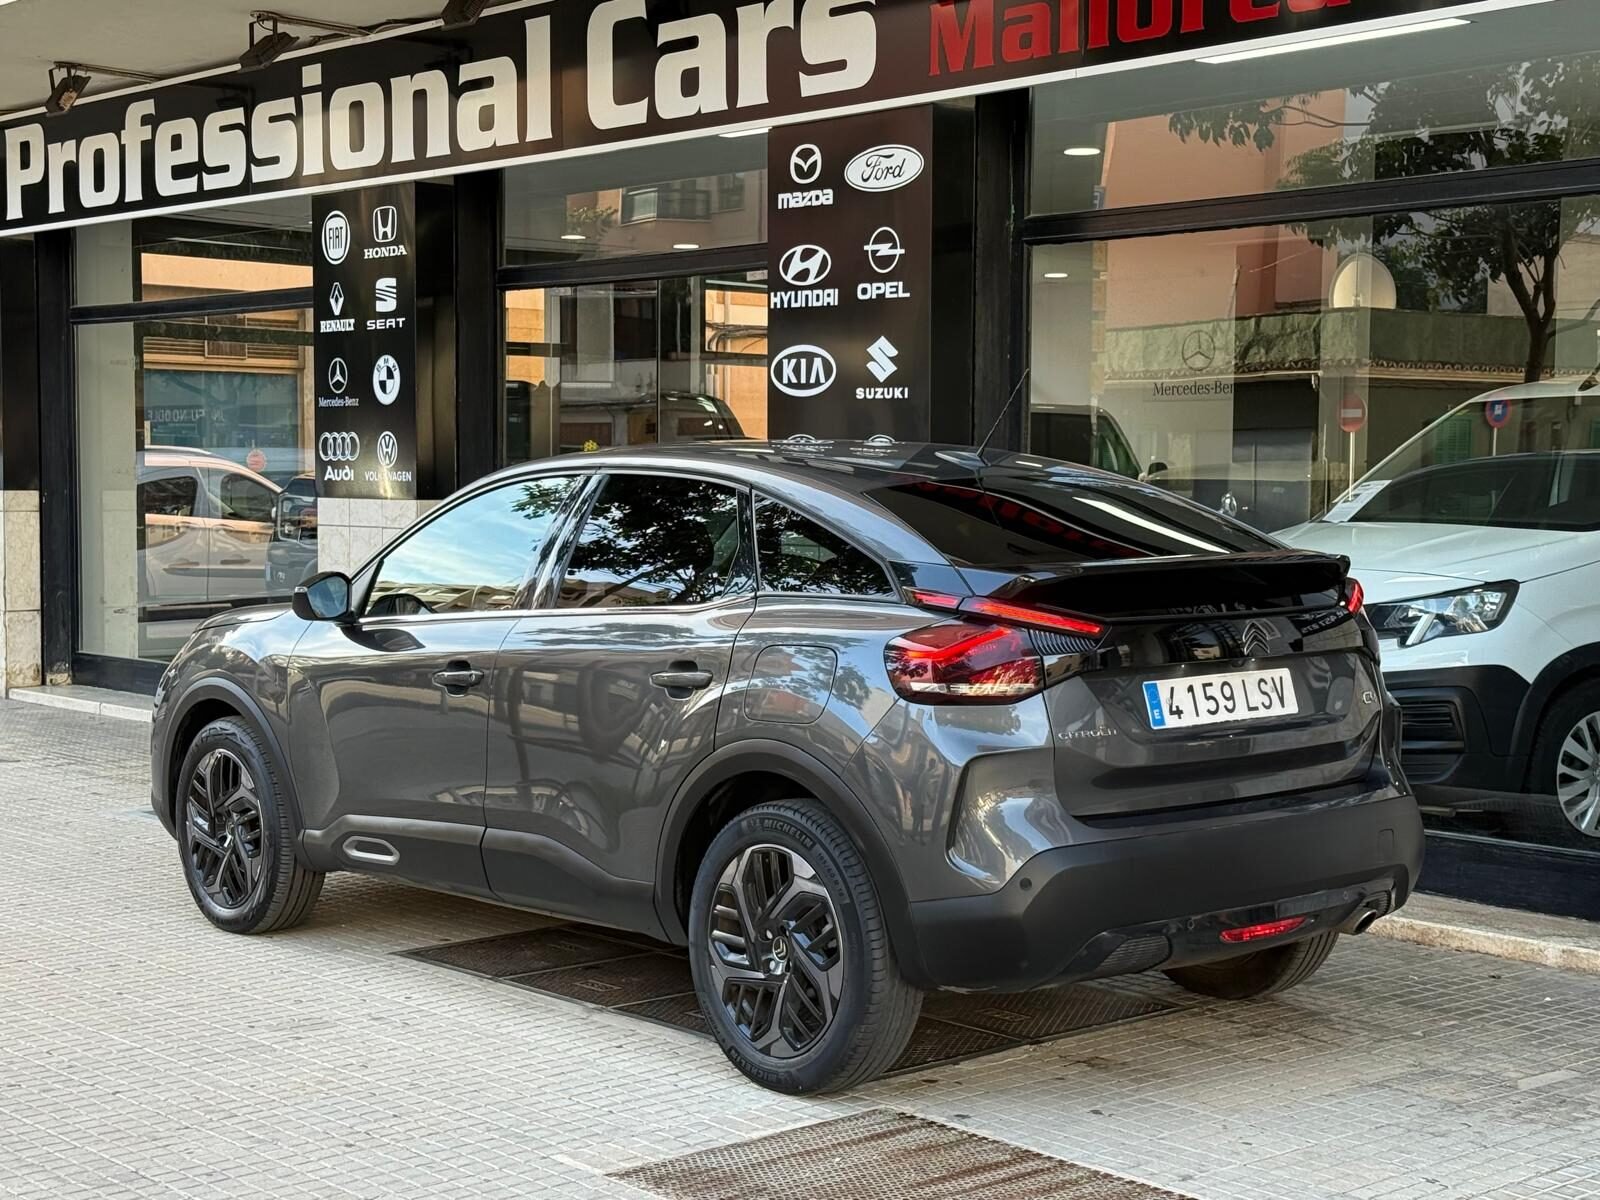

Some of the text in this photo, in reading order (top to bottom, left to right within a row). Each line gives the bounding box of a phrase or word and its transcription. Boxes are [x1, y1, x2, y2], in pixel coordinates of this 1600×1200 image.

[5, 0, 1351, 220] Professional Cars Mallor
[861, 153, 906, 183] Ford
[328, 226, 344, 250] FIAT
[363, 245, 408, 259] HONDA
[770, 288, 839, 309] HYUNDAI
[857, 281, 911, 300] OPEL
[320, 318, 355, 333] RENAULT
[366, 317, 406, 330] SEAT
[782, 357, 826, 384] KIA
[855, 387, 909, 399] SUZUKI
[1152, 380, 1236, 397] Mercedes-Be
[318, 395, 360, 408] Mercedes-Benz
[324, 465, 354, 481] Audi
[364, 470, 412, 482] VOLWAGEN
[1167, 676, 1286, 719] 4159 LSV
[1153, 709, 1161, 720] E
[764, 819, 814, 848] MICHELIN
